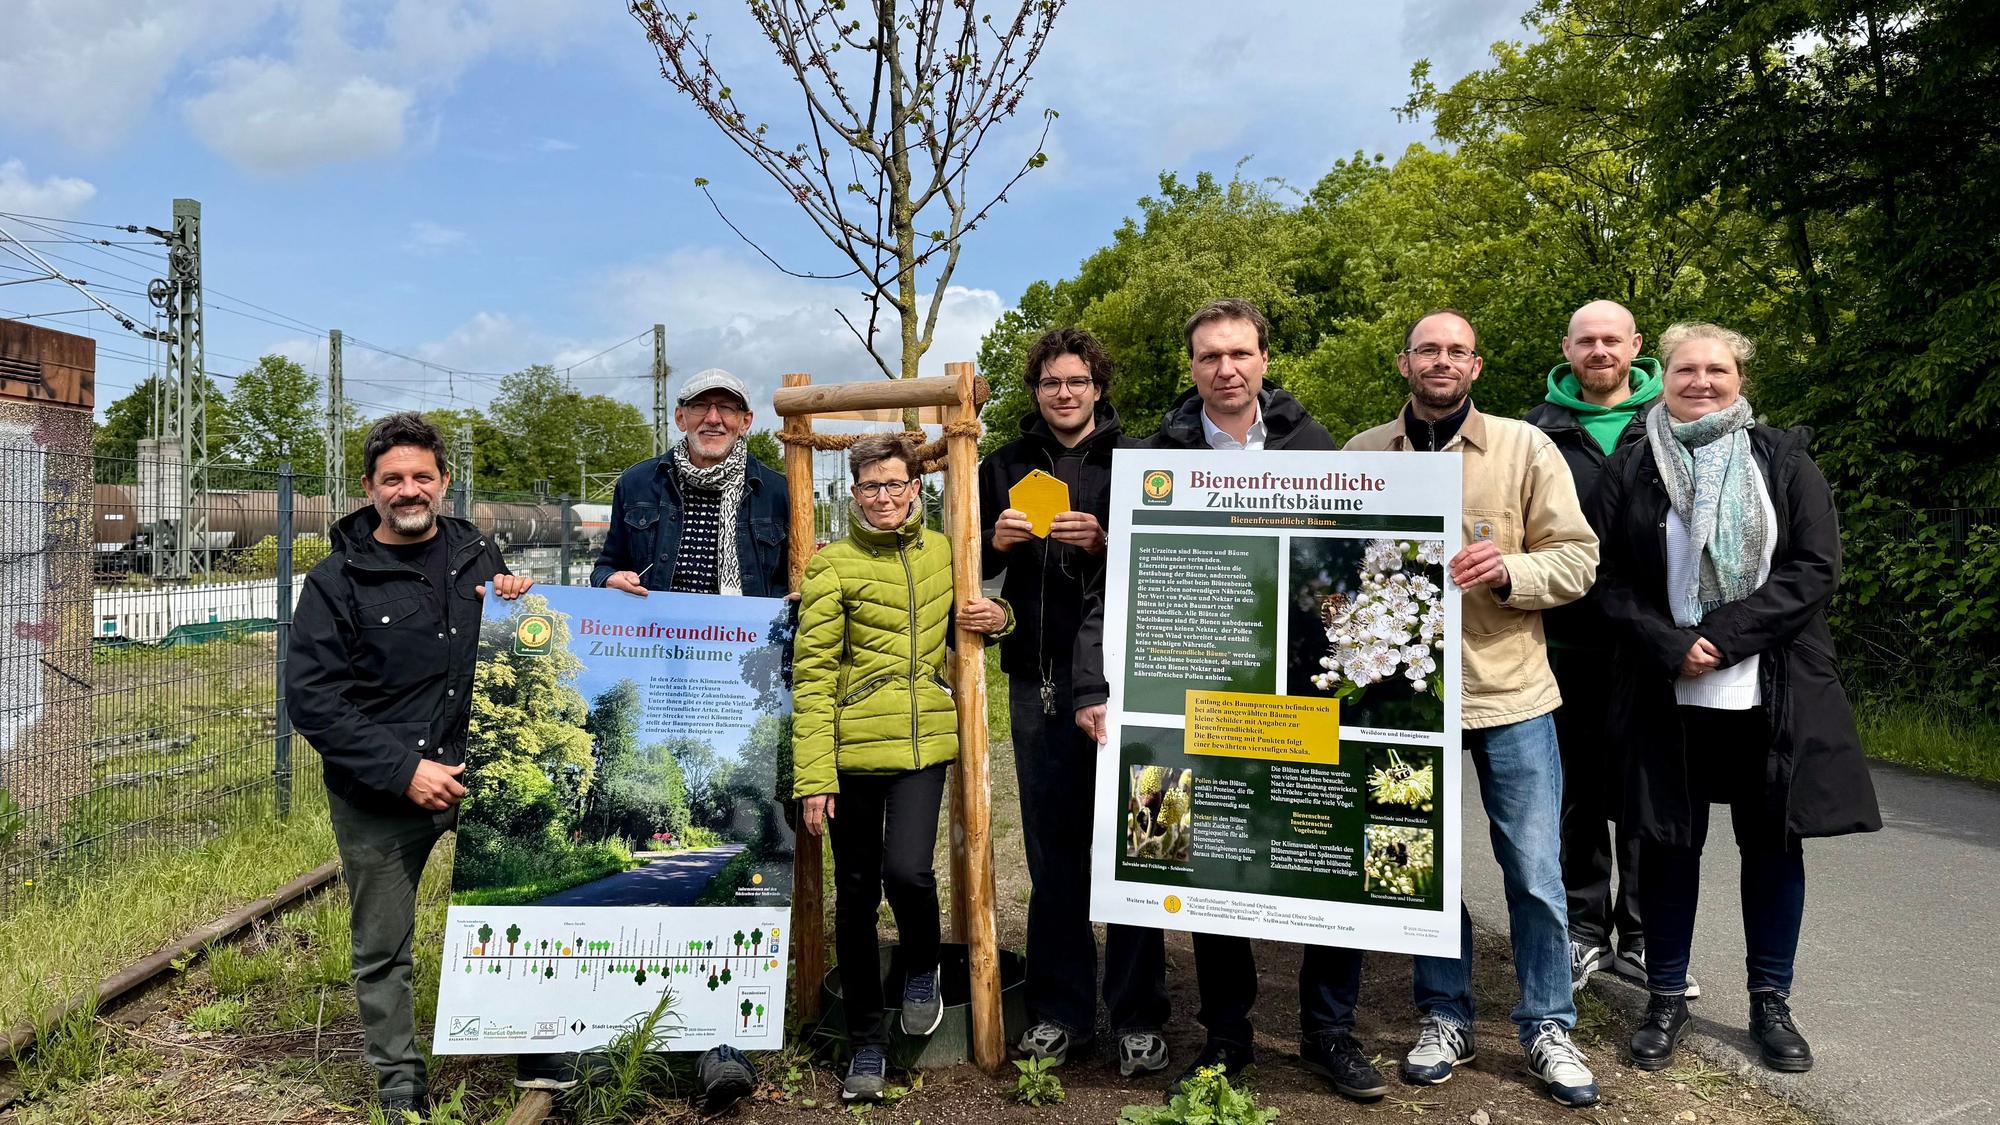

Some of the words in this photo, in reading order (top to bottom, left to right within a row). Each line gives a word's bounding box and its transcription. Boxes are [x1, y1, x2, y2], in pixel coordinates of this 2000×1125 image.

[1190, 470, 1386, 491] Bienenfreundliche
[1206, 491, 1363, 510] Zukunftsbäume
[1231, 516, 1304, 525] Bienenfreundliche
[1307, 517, 1336, 526] Bäume
[1168, 563, 1203, 571] garantieren
[1138, 570, 1172, 578] Bestäubung
[1137, 577, 1166, 585] gewinnen
[1181, 586, 1220, 595] notwendigen
[580, 618, 757, 642] Bienenfreundliche
[1152, 639, 1181, 648] wichtigen
[588, 640, 732, 662] Zukunftsbäume
[1146, 647, 1204, 655] "Bienenfreundliche
[1185, 656, 1219, 664] bezeichnet,
[1134, 670, 1183, 678] nährstoffreichen
[1195, 698, 1220, 707] Entlang
[1234, 700, 1283, 711] Baumparcours
[1284, 703, 1314, 711] befinden
[1223, 708, 1267, 718] ausgewählten
[1269, 710, 1297, 718] Bäumen
[1194, 723, 1264, 733] Bienenfreundlichkeit.
[1256, 718, 1286, 728] Angaben
[1206, 732, 1242, 742] Bewertung
[1256, 735, 1285, 743] Punkten
[1286, 737, 1302, 746] folgt
[1211, 741, 1246, 750] bewährten
[1248, 744, 1287, 754] vierstufigen
[1292, 811, 1330, 820] Bienenschutz
[1290, 818, 1332, 828] Insektenschutz
[1293, 826, 1327, 836] Vogelschutz
